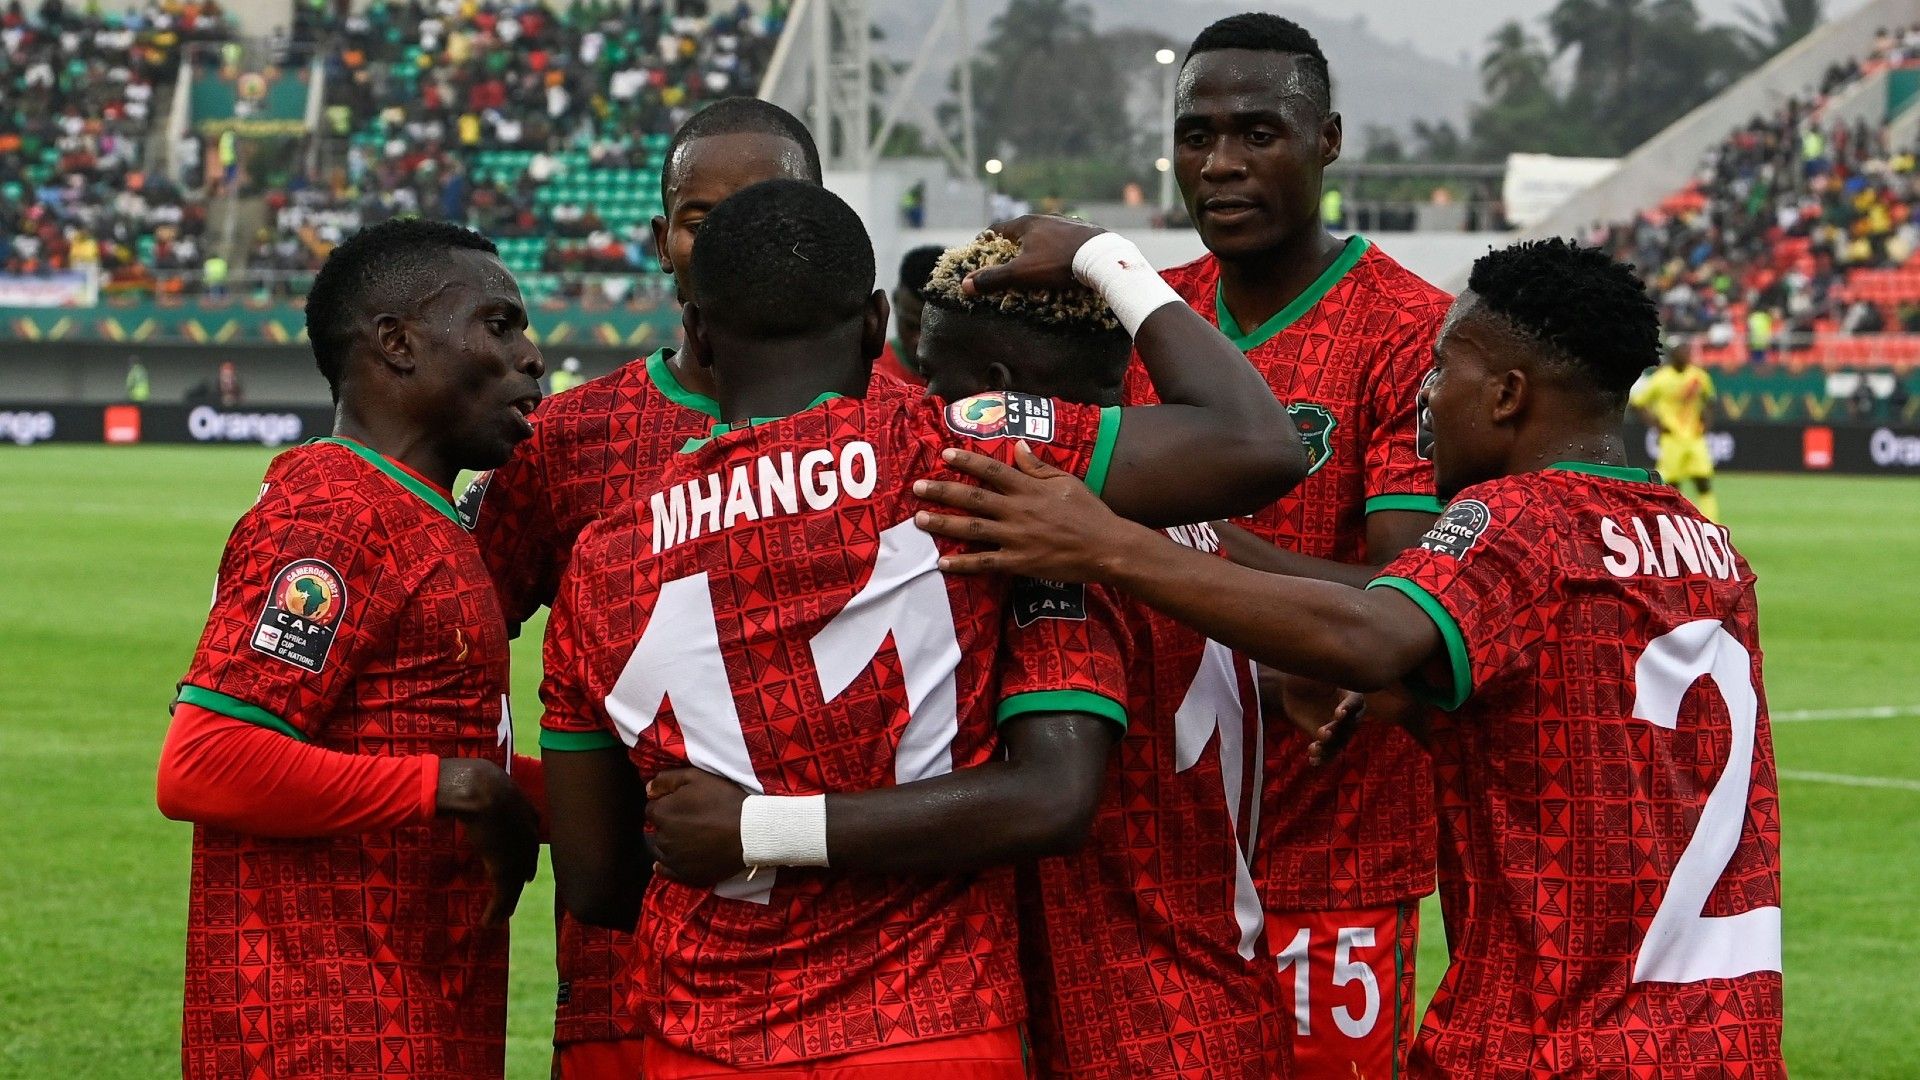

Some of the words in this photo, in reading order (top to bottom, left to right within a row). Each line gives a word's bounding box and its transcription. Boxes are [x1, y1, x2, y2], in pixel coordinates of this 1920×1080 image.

[1008, 394, 1020, 423] CAF
[188, 405, 302, 446] Orange
[651, 441, 877, 555] MHANGO
[286, 566, 330, 582] CAMEROON
[326, 578, 339, 598] 2021
[1029, 599, 1071, 613] CAF
[277, 612, 320, 635] CAF
[281, 640, 295, 650] CUP
[284, 632, 307, 647] AFRICA
[278, 647, 288, 656] OF
[288, 648, 315, 667] NATIONS
[605, 516, 962, 906] 11
[1632, 619, 1783, 984] 2
[1276, 927, 1381, 1039] 15
